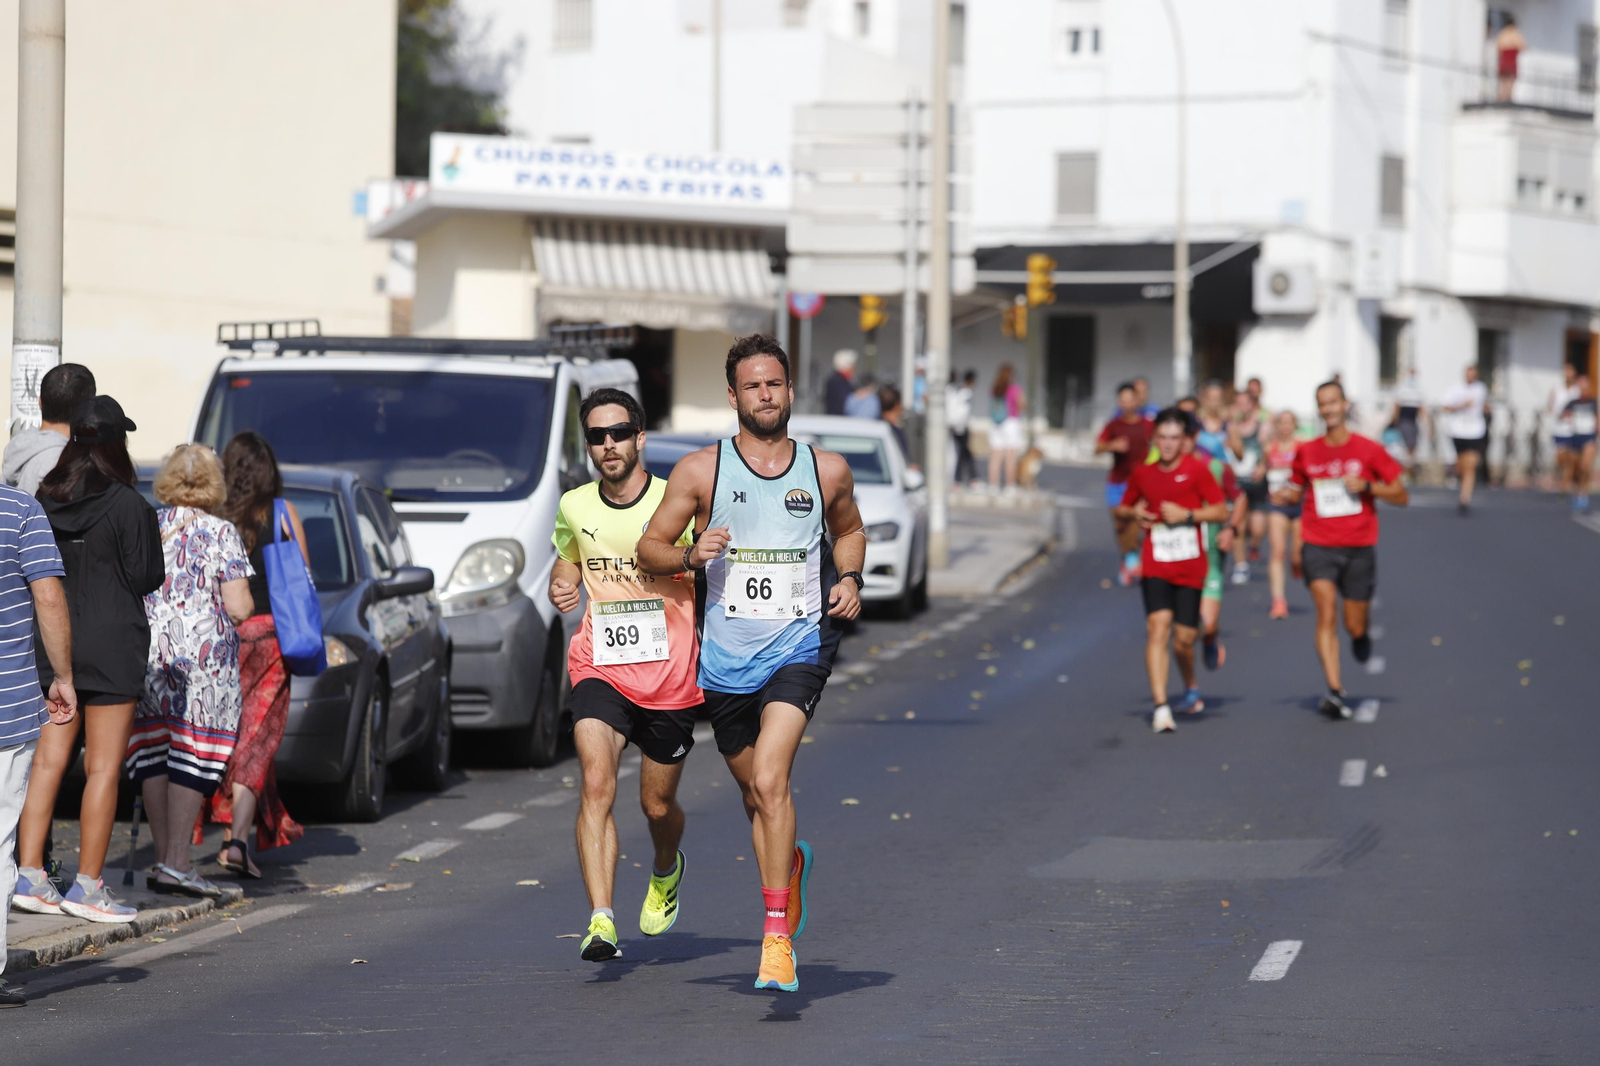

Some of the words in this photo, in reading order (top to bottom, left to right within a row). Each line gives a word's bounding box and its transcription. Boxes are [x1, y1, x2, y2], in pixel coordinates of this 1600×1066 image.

[474, 145, 617, 170] CHURROS
[643, 152, 816, 179] CHOCOLA
[515, 171, 650, 194] PATATAS
[660, 178, 766, 201] FRITAS
[586, 557, 638, 571] ETIH
[740, 551, 767, 562] VUELTA
[769, 552, 775, 562] A
[776, 551, 802, 562] HUELVA
[601, 574, 656, 583] AIRWAYS
[745, 576, 773, 600] 66
[603, 603, 626, 614] VUELTA
[626, 603, 632, 612] A
[633, 601, 659, 612] HUELVA
[604, 624, 640, 648] 369
